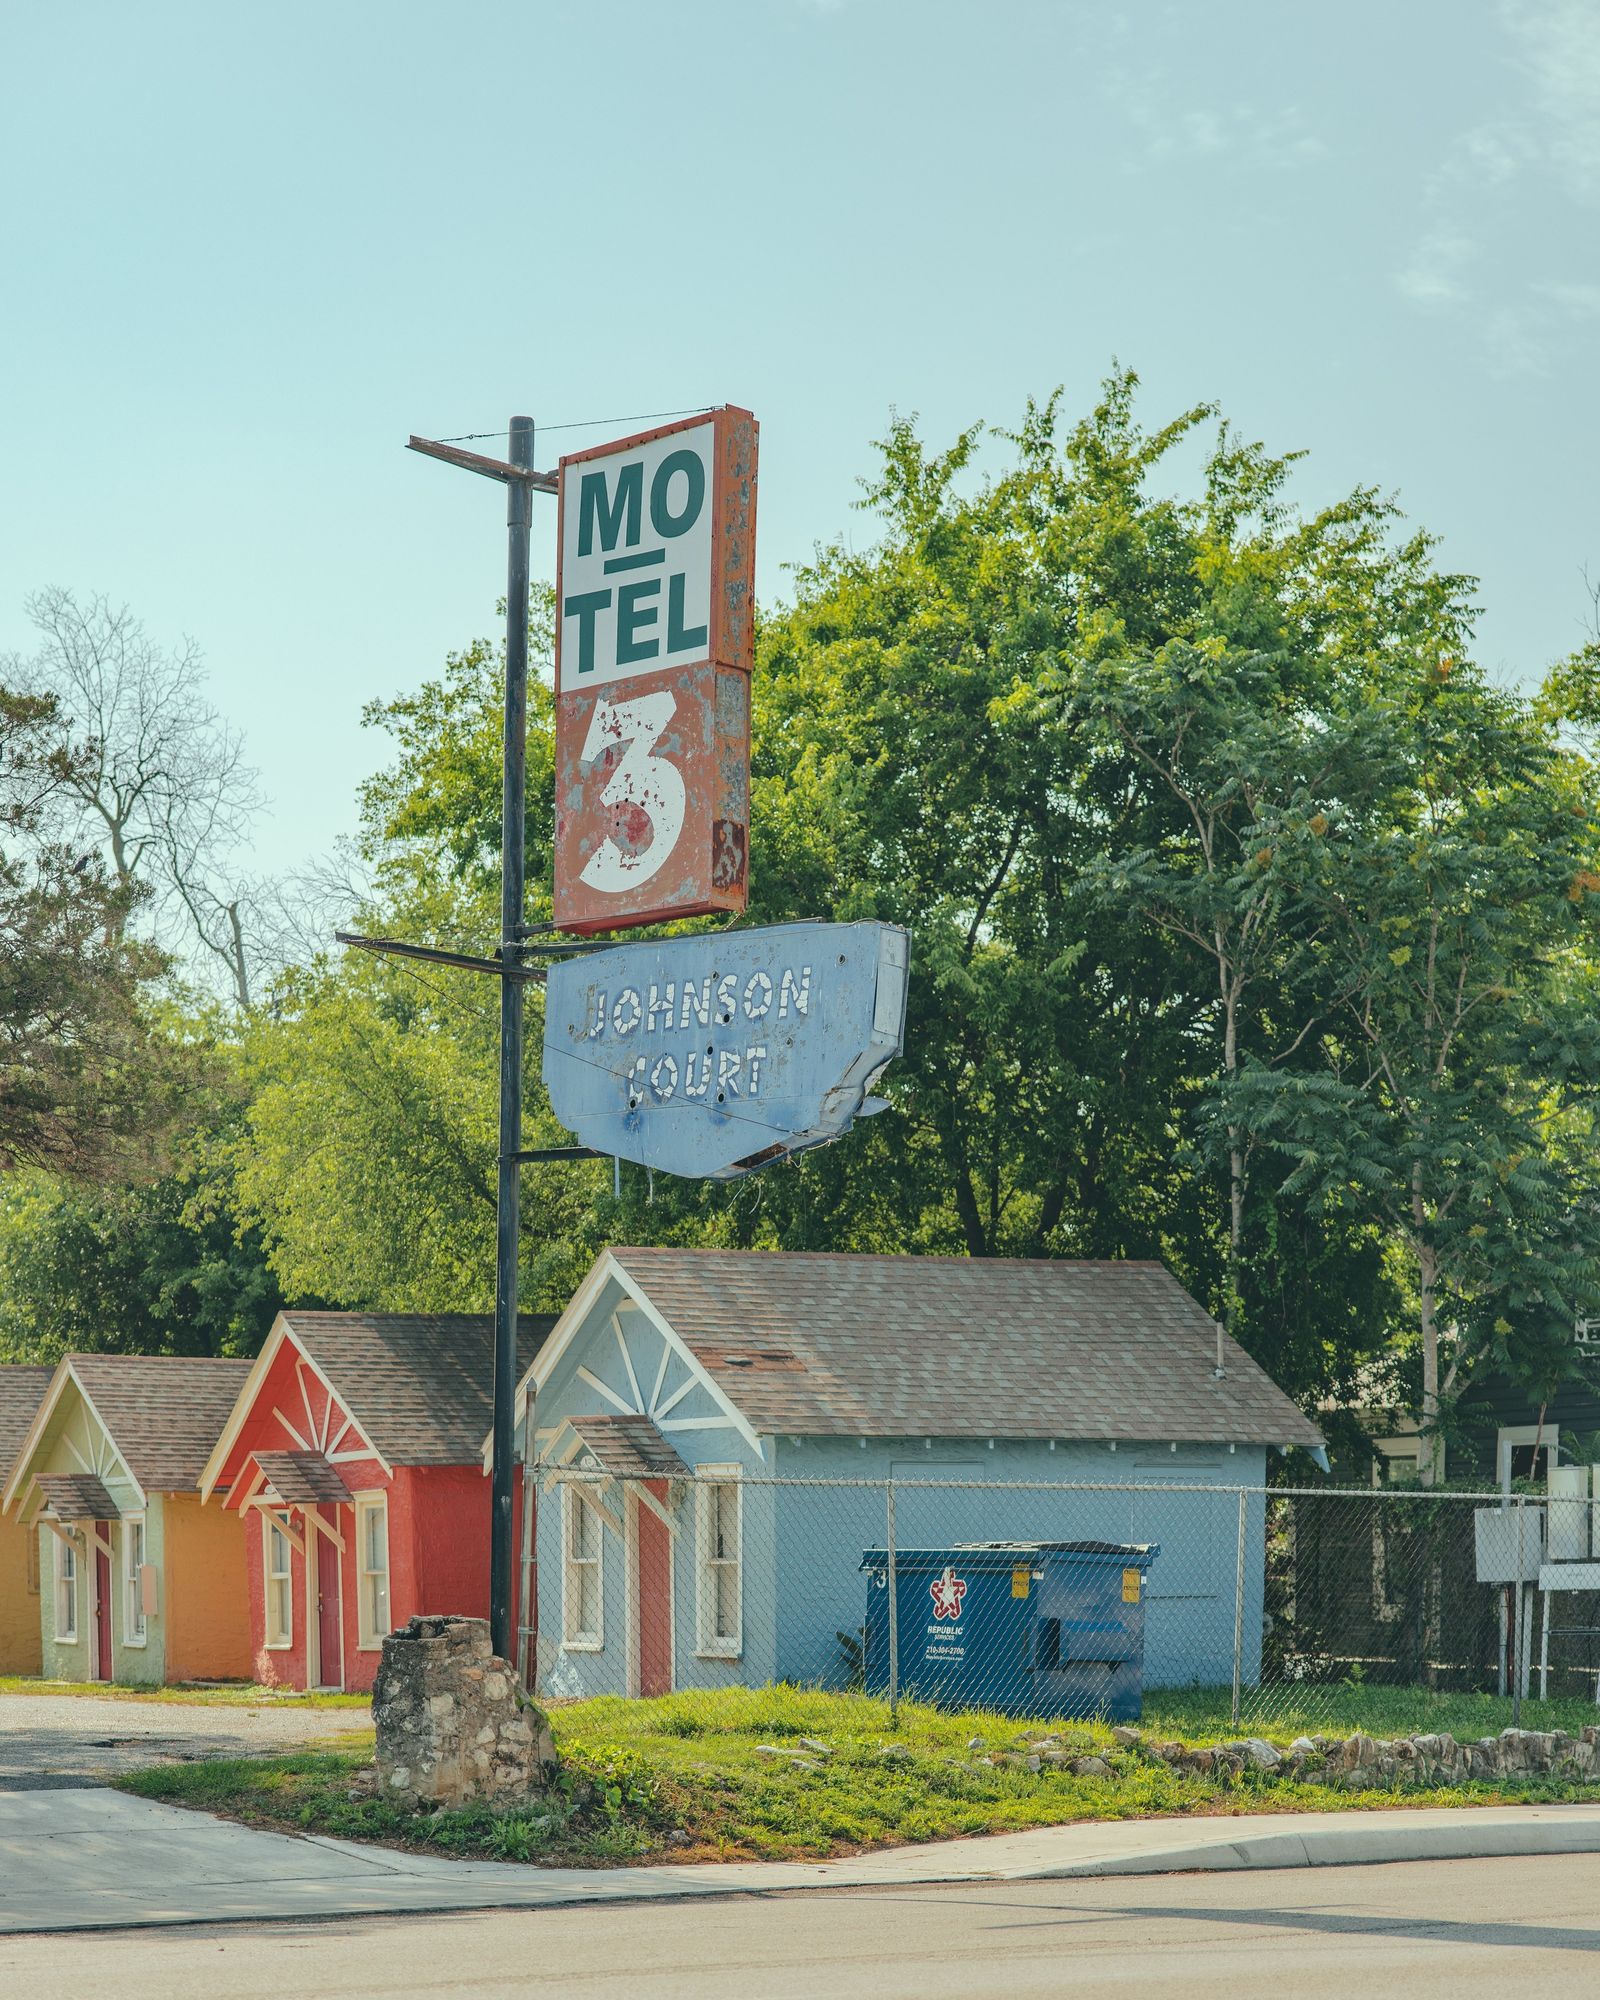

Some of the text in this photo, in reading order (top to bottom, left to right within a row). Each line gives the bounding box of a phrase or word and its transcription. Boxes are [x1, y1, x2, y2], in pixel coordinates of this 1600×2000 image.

[578, 449, 706, 557] MO
[564, 572, 708, 674] TEL
[578, 689, 687, 894] 3
[586, 966, 812, 1037] JOHNSON
[627, 1046, 767, 1104] COURT
[927, 1625, 963, 1635] REPUBLIC
